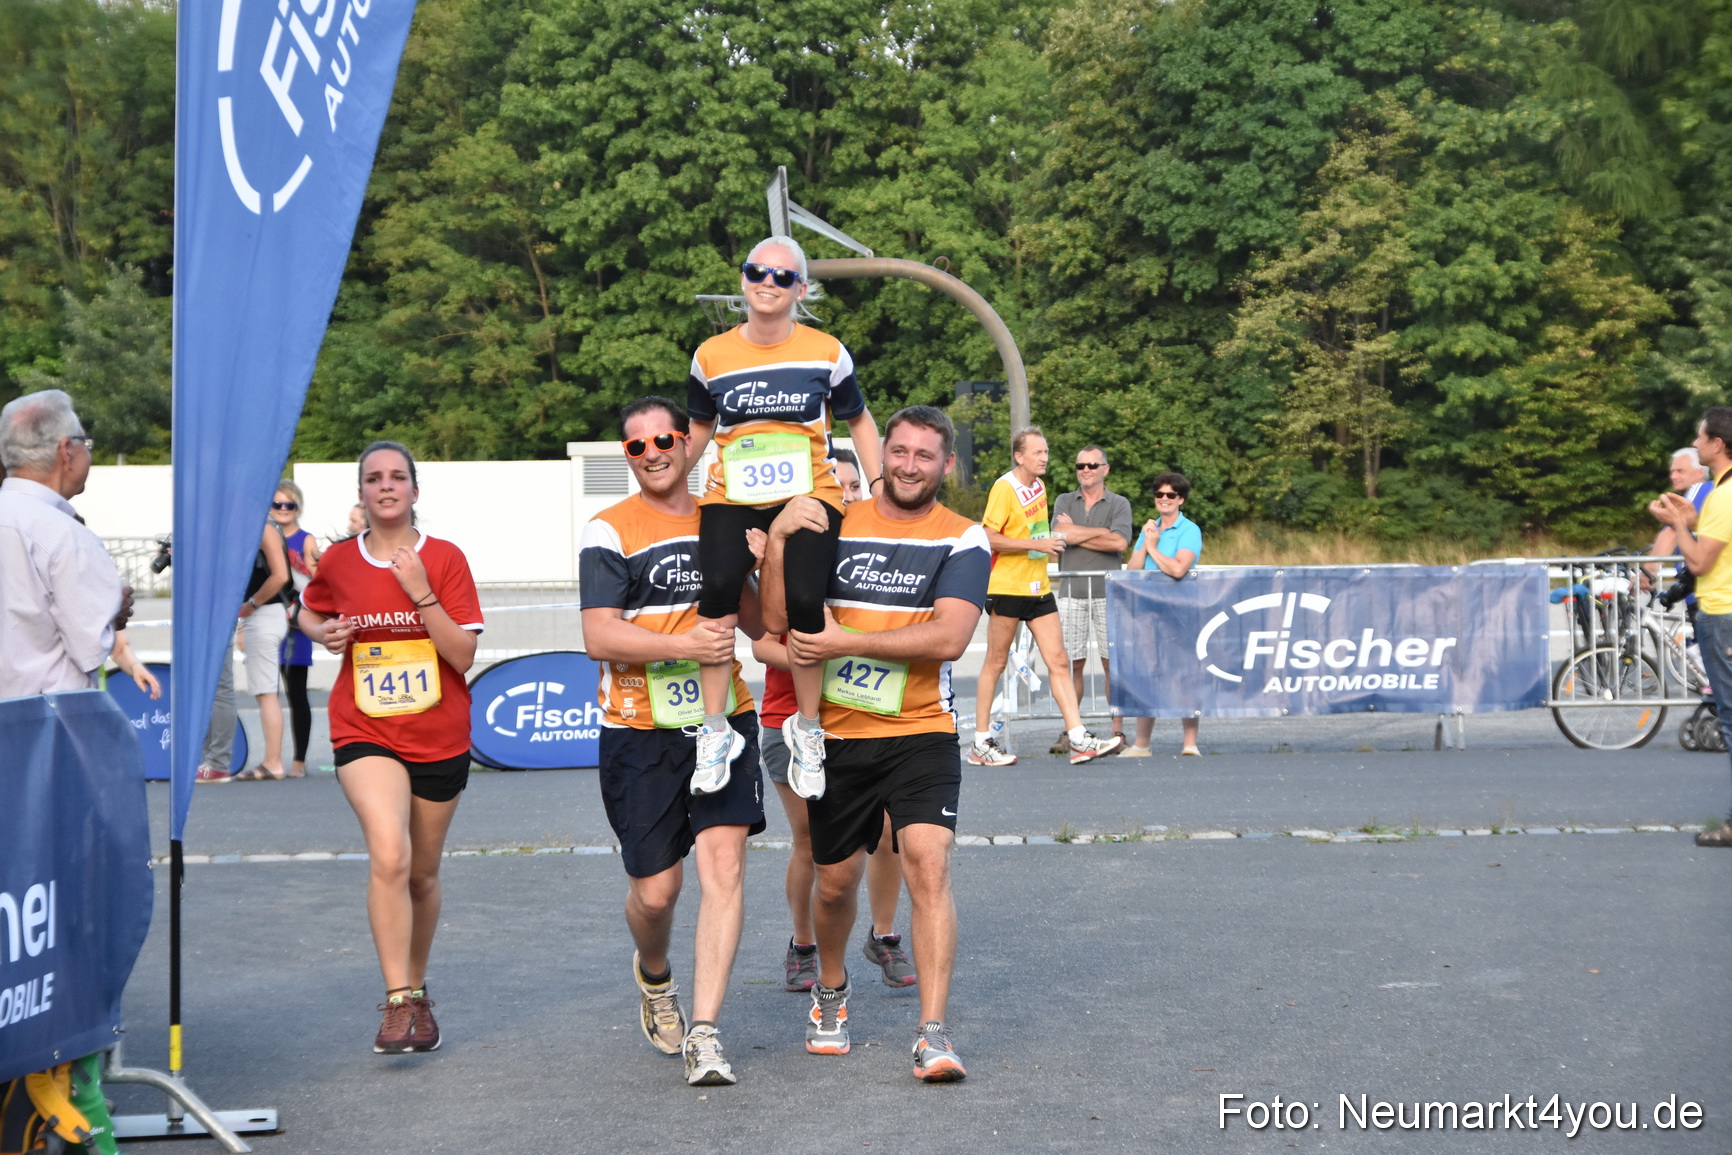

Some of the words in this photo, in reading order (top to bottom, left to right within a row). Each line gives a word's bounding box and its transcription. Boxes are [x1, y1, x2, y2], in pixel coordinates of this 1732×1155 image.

[737, 391, 810, 407] Fischer
[745, 405, 806, 414] AUTOMOBILE
[743, 461, 794, 487] 399
[667, 569, 703, 585] Fisc
[850, 565, 926, 586] Fischer
[855, 582, 917, 594] AUTOMOBILE
[1243, 628, 1457, 670] Fischer
[363, 669, 428, 697] 1411
[837, 660, 890, 691] 427
[1263, 673, 1439, 693] AUTOMOBILE
[667, 679, 700, 706] 39
[837, 687, 855, 696] Markus
[529, 728, 601, 742] AUTOMO
